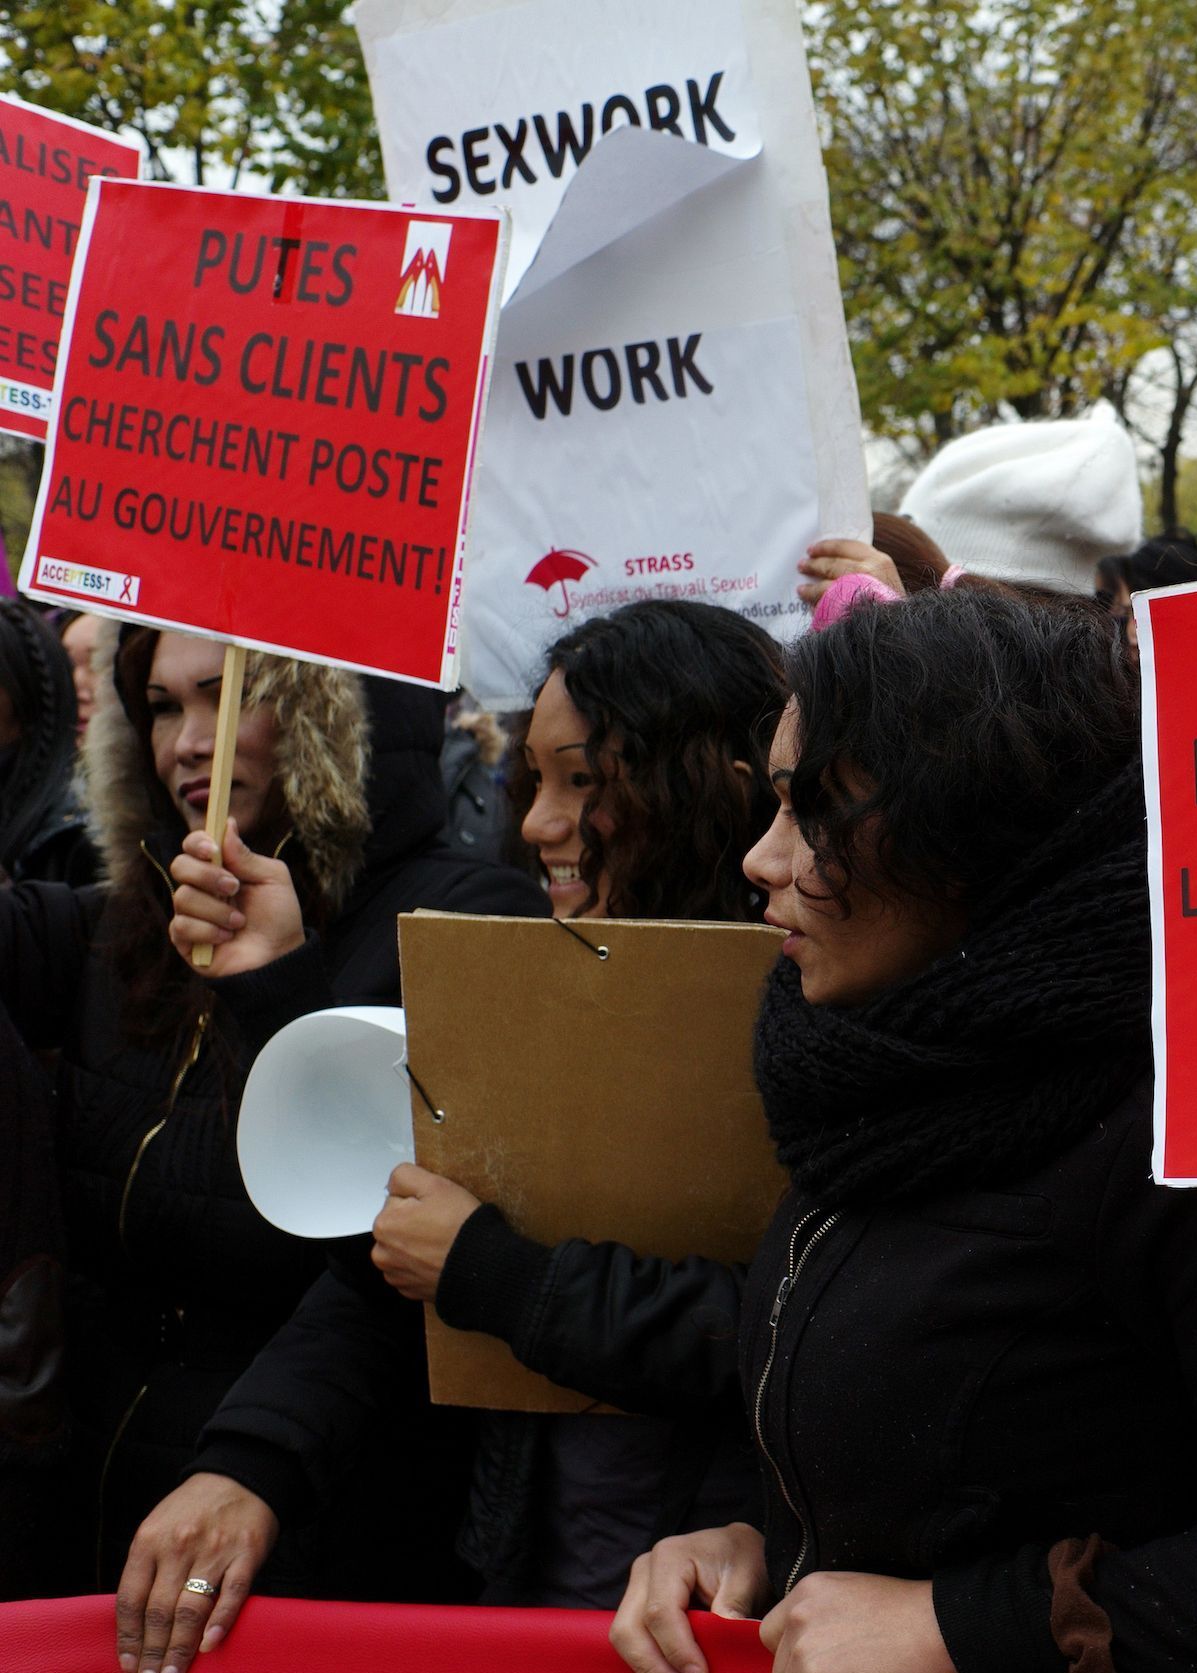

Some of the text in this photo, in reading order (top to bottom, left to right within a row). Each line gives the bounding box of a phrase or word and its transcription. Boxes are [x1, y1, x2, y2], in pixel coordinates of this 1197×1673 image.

[194, 230, 357, 306] PUTES
[89, 310, 450, 424] SANS CLIENTS
[513, 333, 714, 421] WORK
[63, 396, 443, 508] CHERCHENT POSTE
[51, 475, 446, 595] AU GOUVERNEMENT!
[624, 553, 695, 576] STRASS
[42, 564, 111, 591] ACCEPTESS-T
[656, 578, 706, 598] Travail
[711, 572, 758, 593] Sexuel
